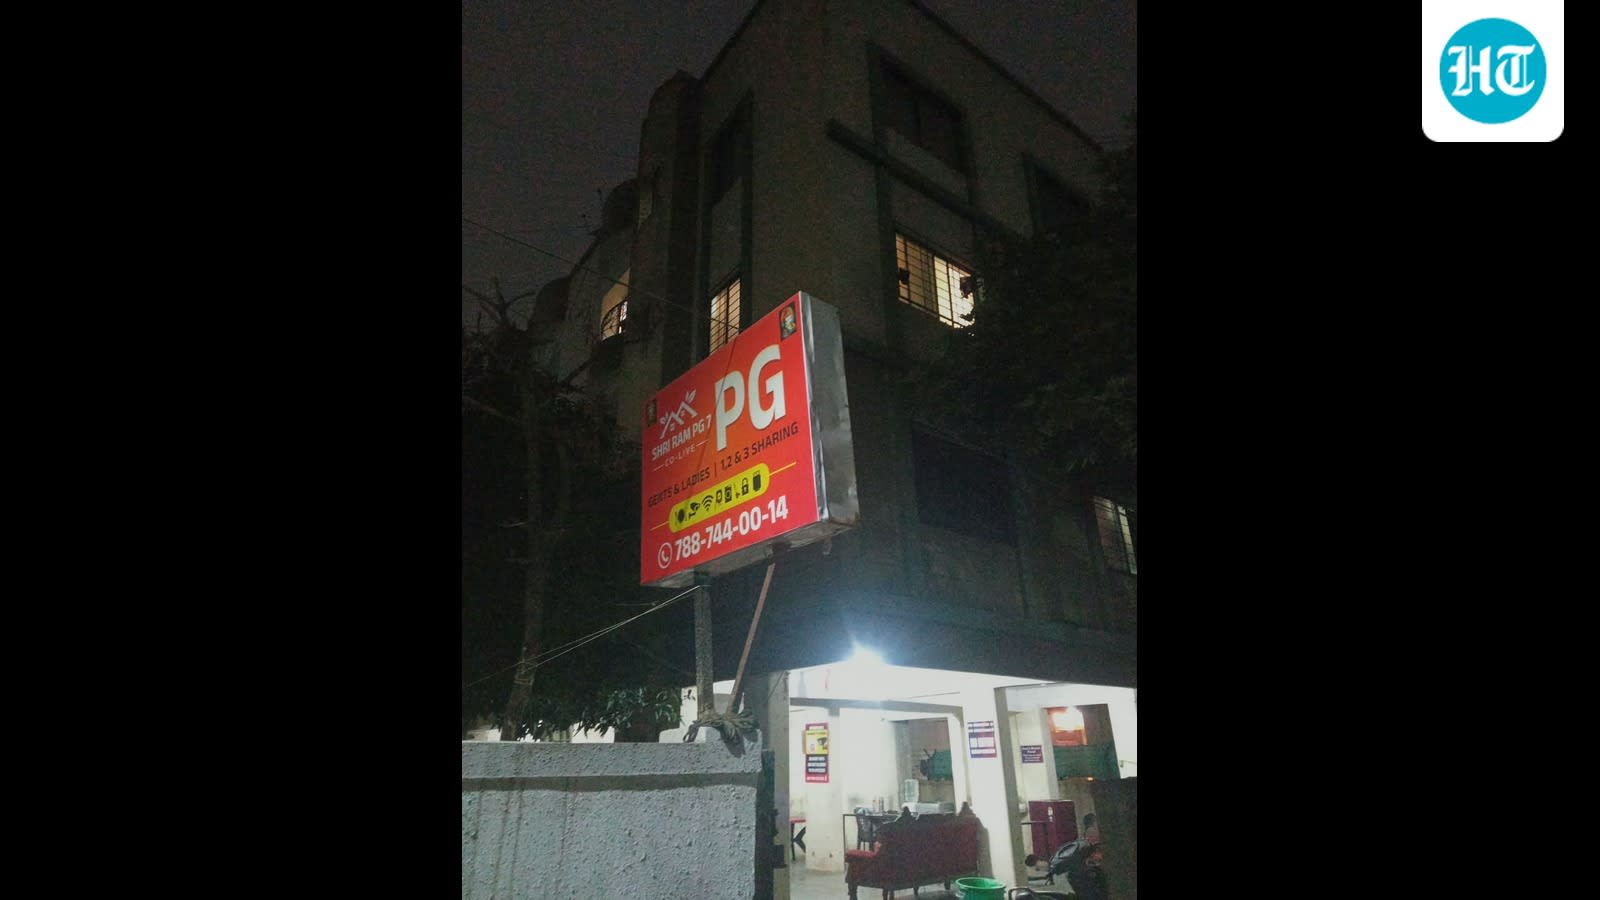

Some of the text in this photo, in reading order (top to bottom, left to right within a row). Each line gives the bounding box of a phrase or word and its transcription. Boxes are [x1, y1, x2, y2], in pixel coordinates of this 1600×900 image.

[715, 344, 786, 452] PG
[648, 485, 673, 508] GENTS
[673, 483, 680, 495] &
[681, 467, 710, 491] LADIES
[735, 451, 742, 464] &
[743, 447, 750, 460] 3
[751, 421, 799, 455] SHARING
[652, 413, 712, 461] SHRI RAM PG 7
[664, 444, 696, 467] CO-LIVE
[674, 495, 789, 561] 788-744-00-14
